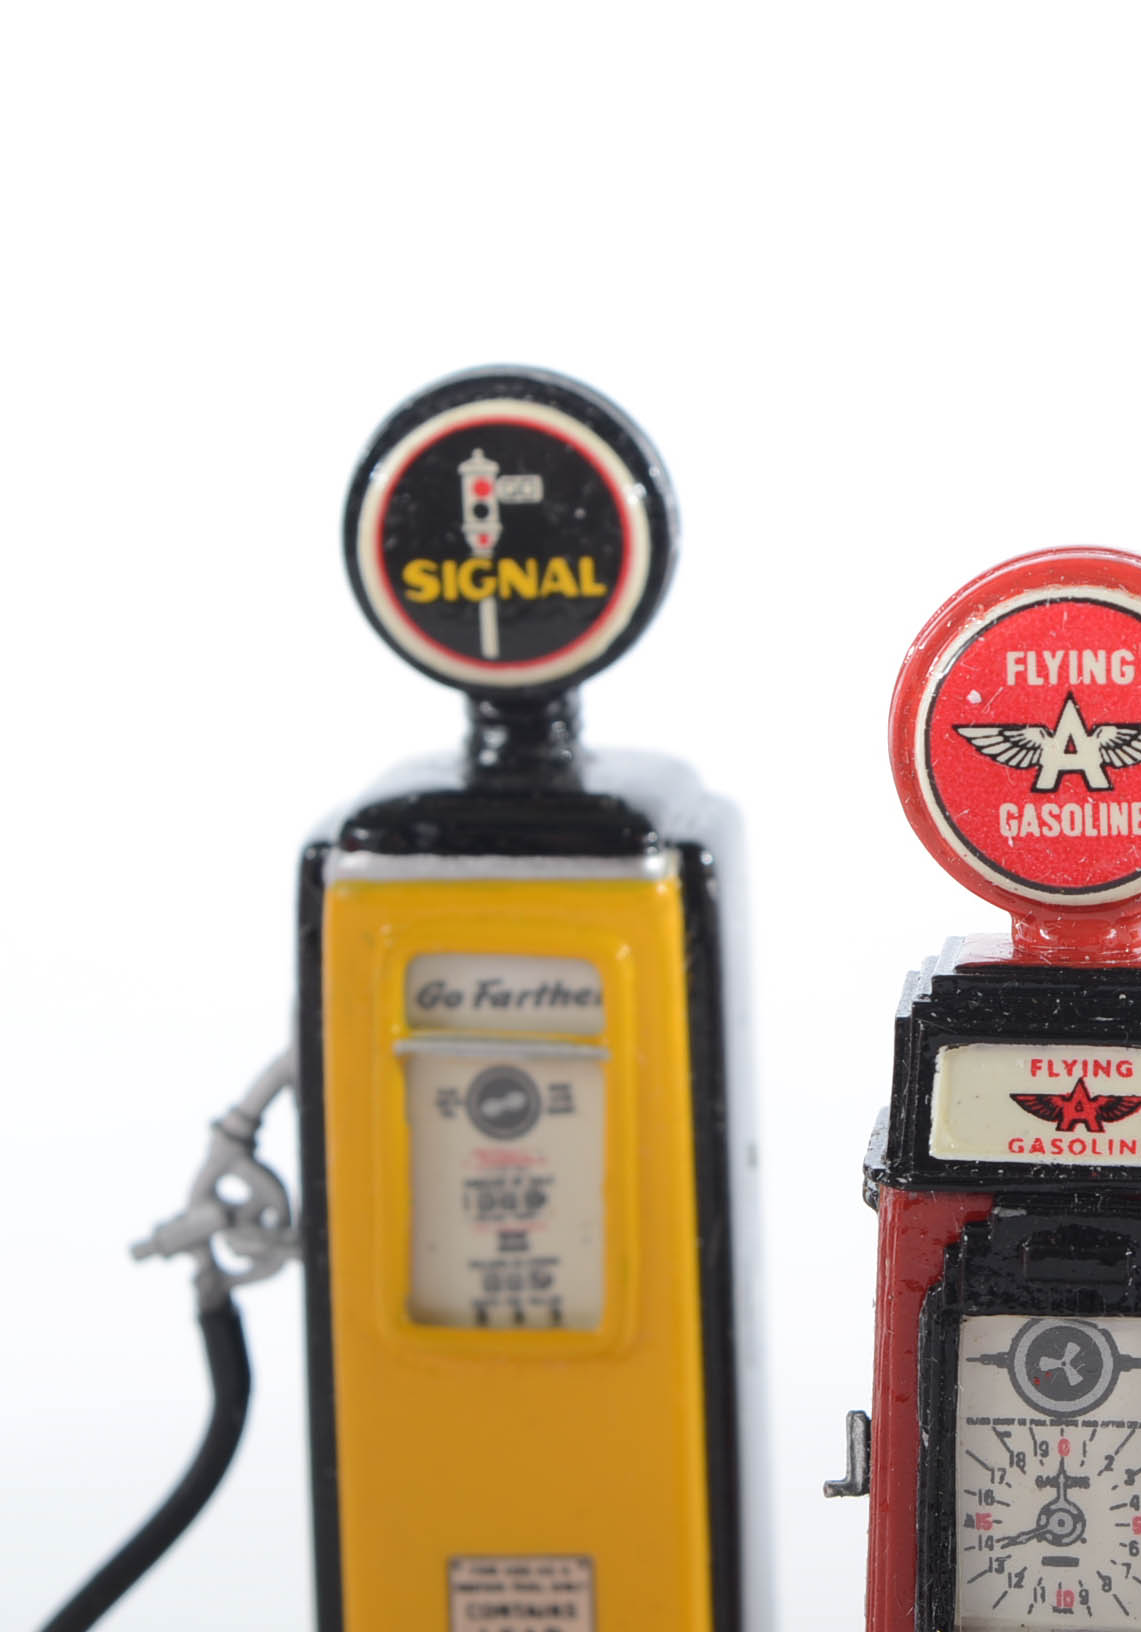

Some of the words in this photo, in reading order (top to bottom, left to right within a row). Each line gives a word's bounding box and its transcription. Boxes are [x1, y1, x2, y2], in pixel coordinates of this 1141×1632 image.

[402, 556, 607, 603] SIGNAL
[1006, 649, 1136, 686] FLYING
[416, 979, 464, 1011] Go
[1030, 1058, 1134, 1078] FLYING
[1104, 1454, 1115, 1471] 2
[991, 1468, 1007, 1485] 17
[1129, 1494, 1140, 1511] 4
[976, 1512, 993, 1531] 15
[978, 1534, 994, 1551] 14
[1129, 1540, 1140, 1557] 6
[1121, 1562, 1131, 1579] 7
[1008, 1572, 1024, 1588] 12
[1102, 1575, 1112, 1593] 8
[1056, 1589, 1075, 1608] 10
[1079, 1589, 1089, 1605] 9
